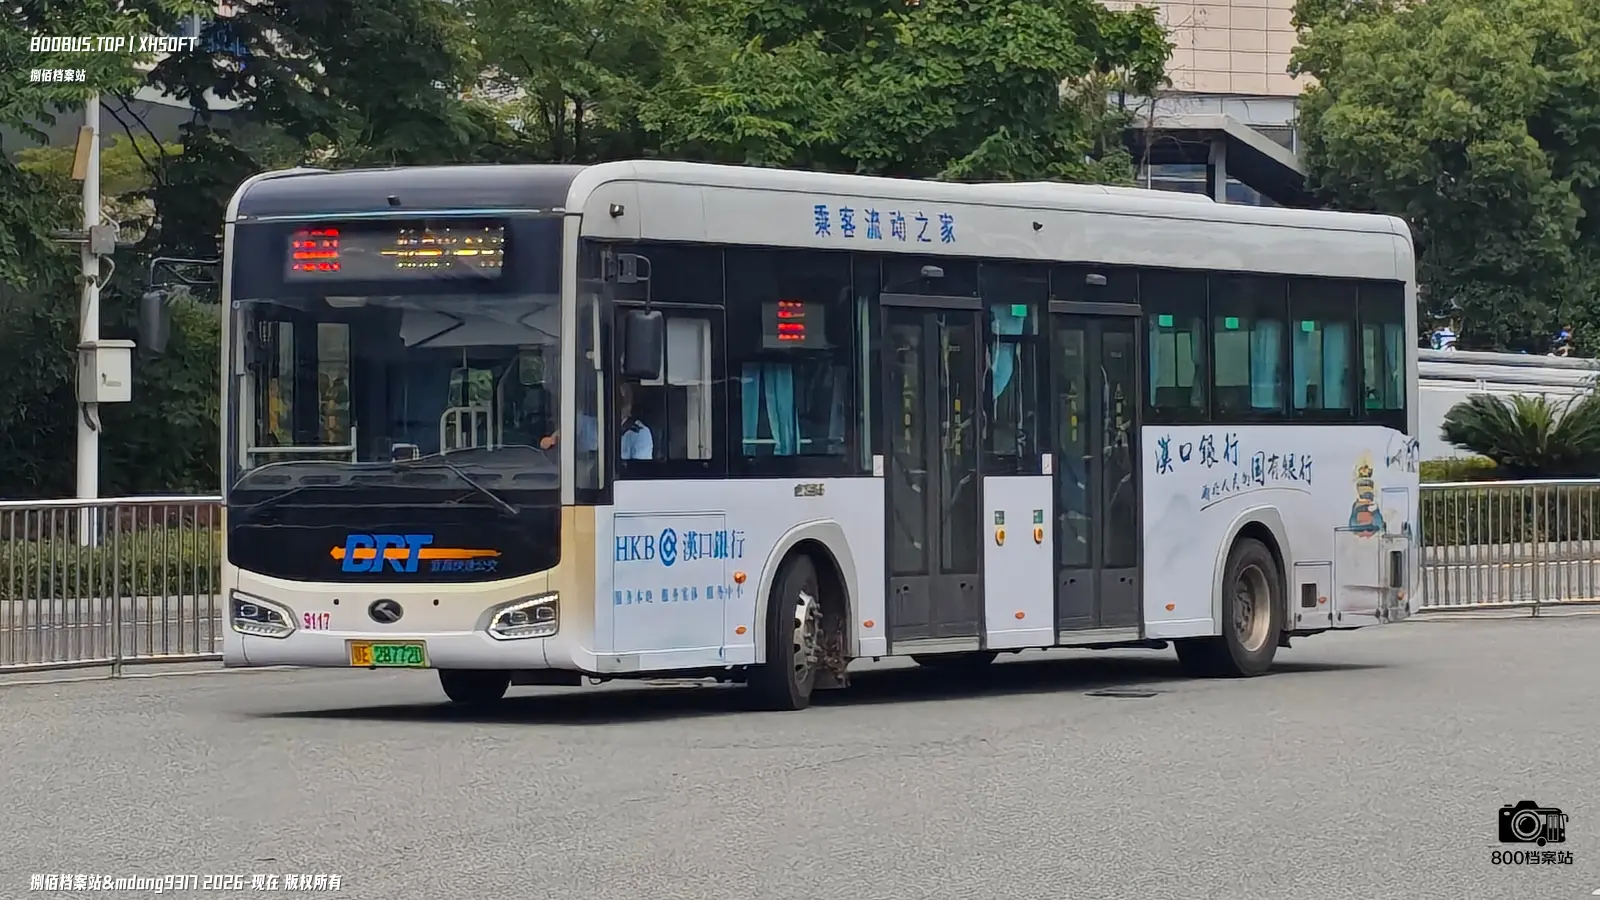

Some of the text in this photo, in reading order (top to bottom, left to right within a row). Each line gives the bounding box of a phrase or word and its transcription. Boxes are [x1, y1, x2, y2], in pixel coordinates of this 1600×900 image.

[813, 204, 957, 244] 乘客流动之家
[341, 533, 434, 573] BRT
[615, 535, 656, 562] HKB
[304, 612, 330, 630] 9117
